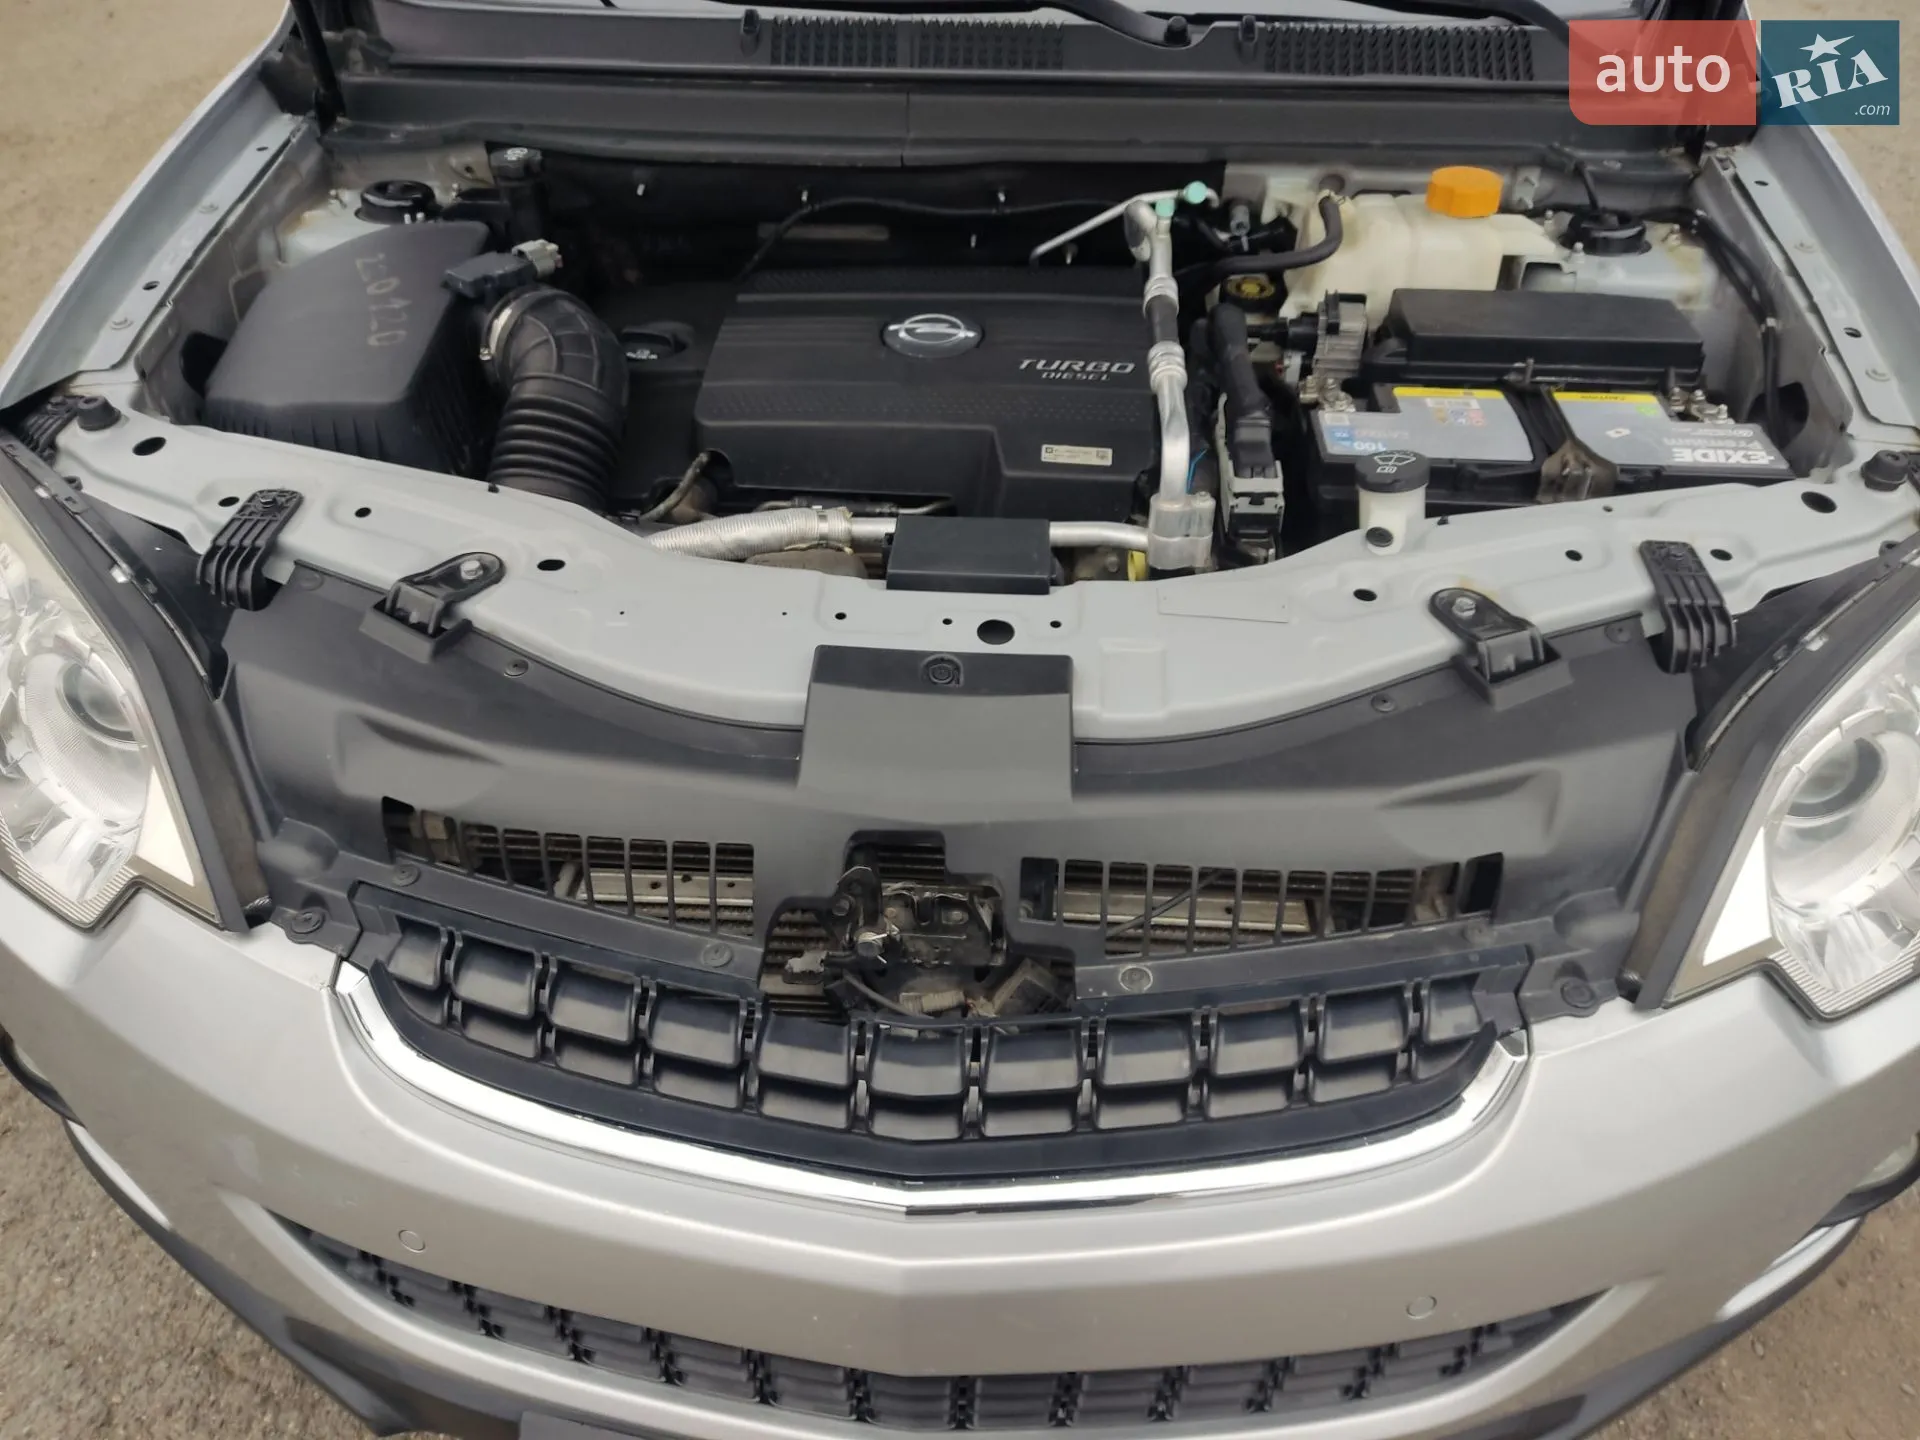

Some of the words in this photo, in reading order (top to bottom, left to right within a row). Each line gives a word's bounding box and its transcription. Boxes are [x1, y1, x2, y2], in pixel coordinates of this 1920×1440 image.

[1019, 359, 1136, 374] TURBO
[1041, 371, 1111, 381] DIESEL
[1671, 447, 1776, 465] EXIDE
